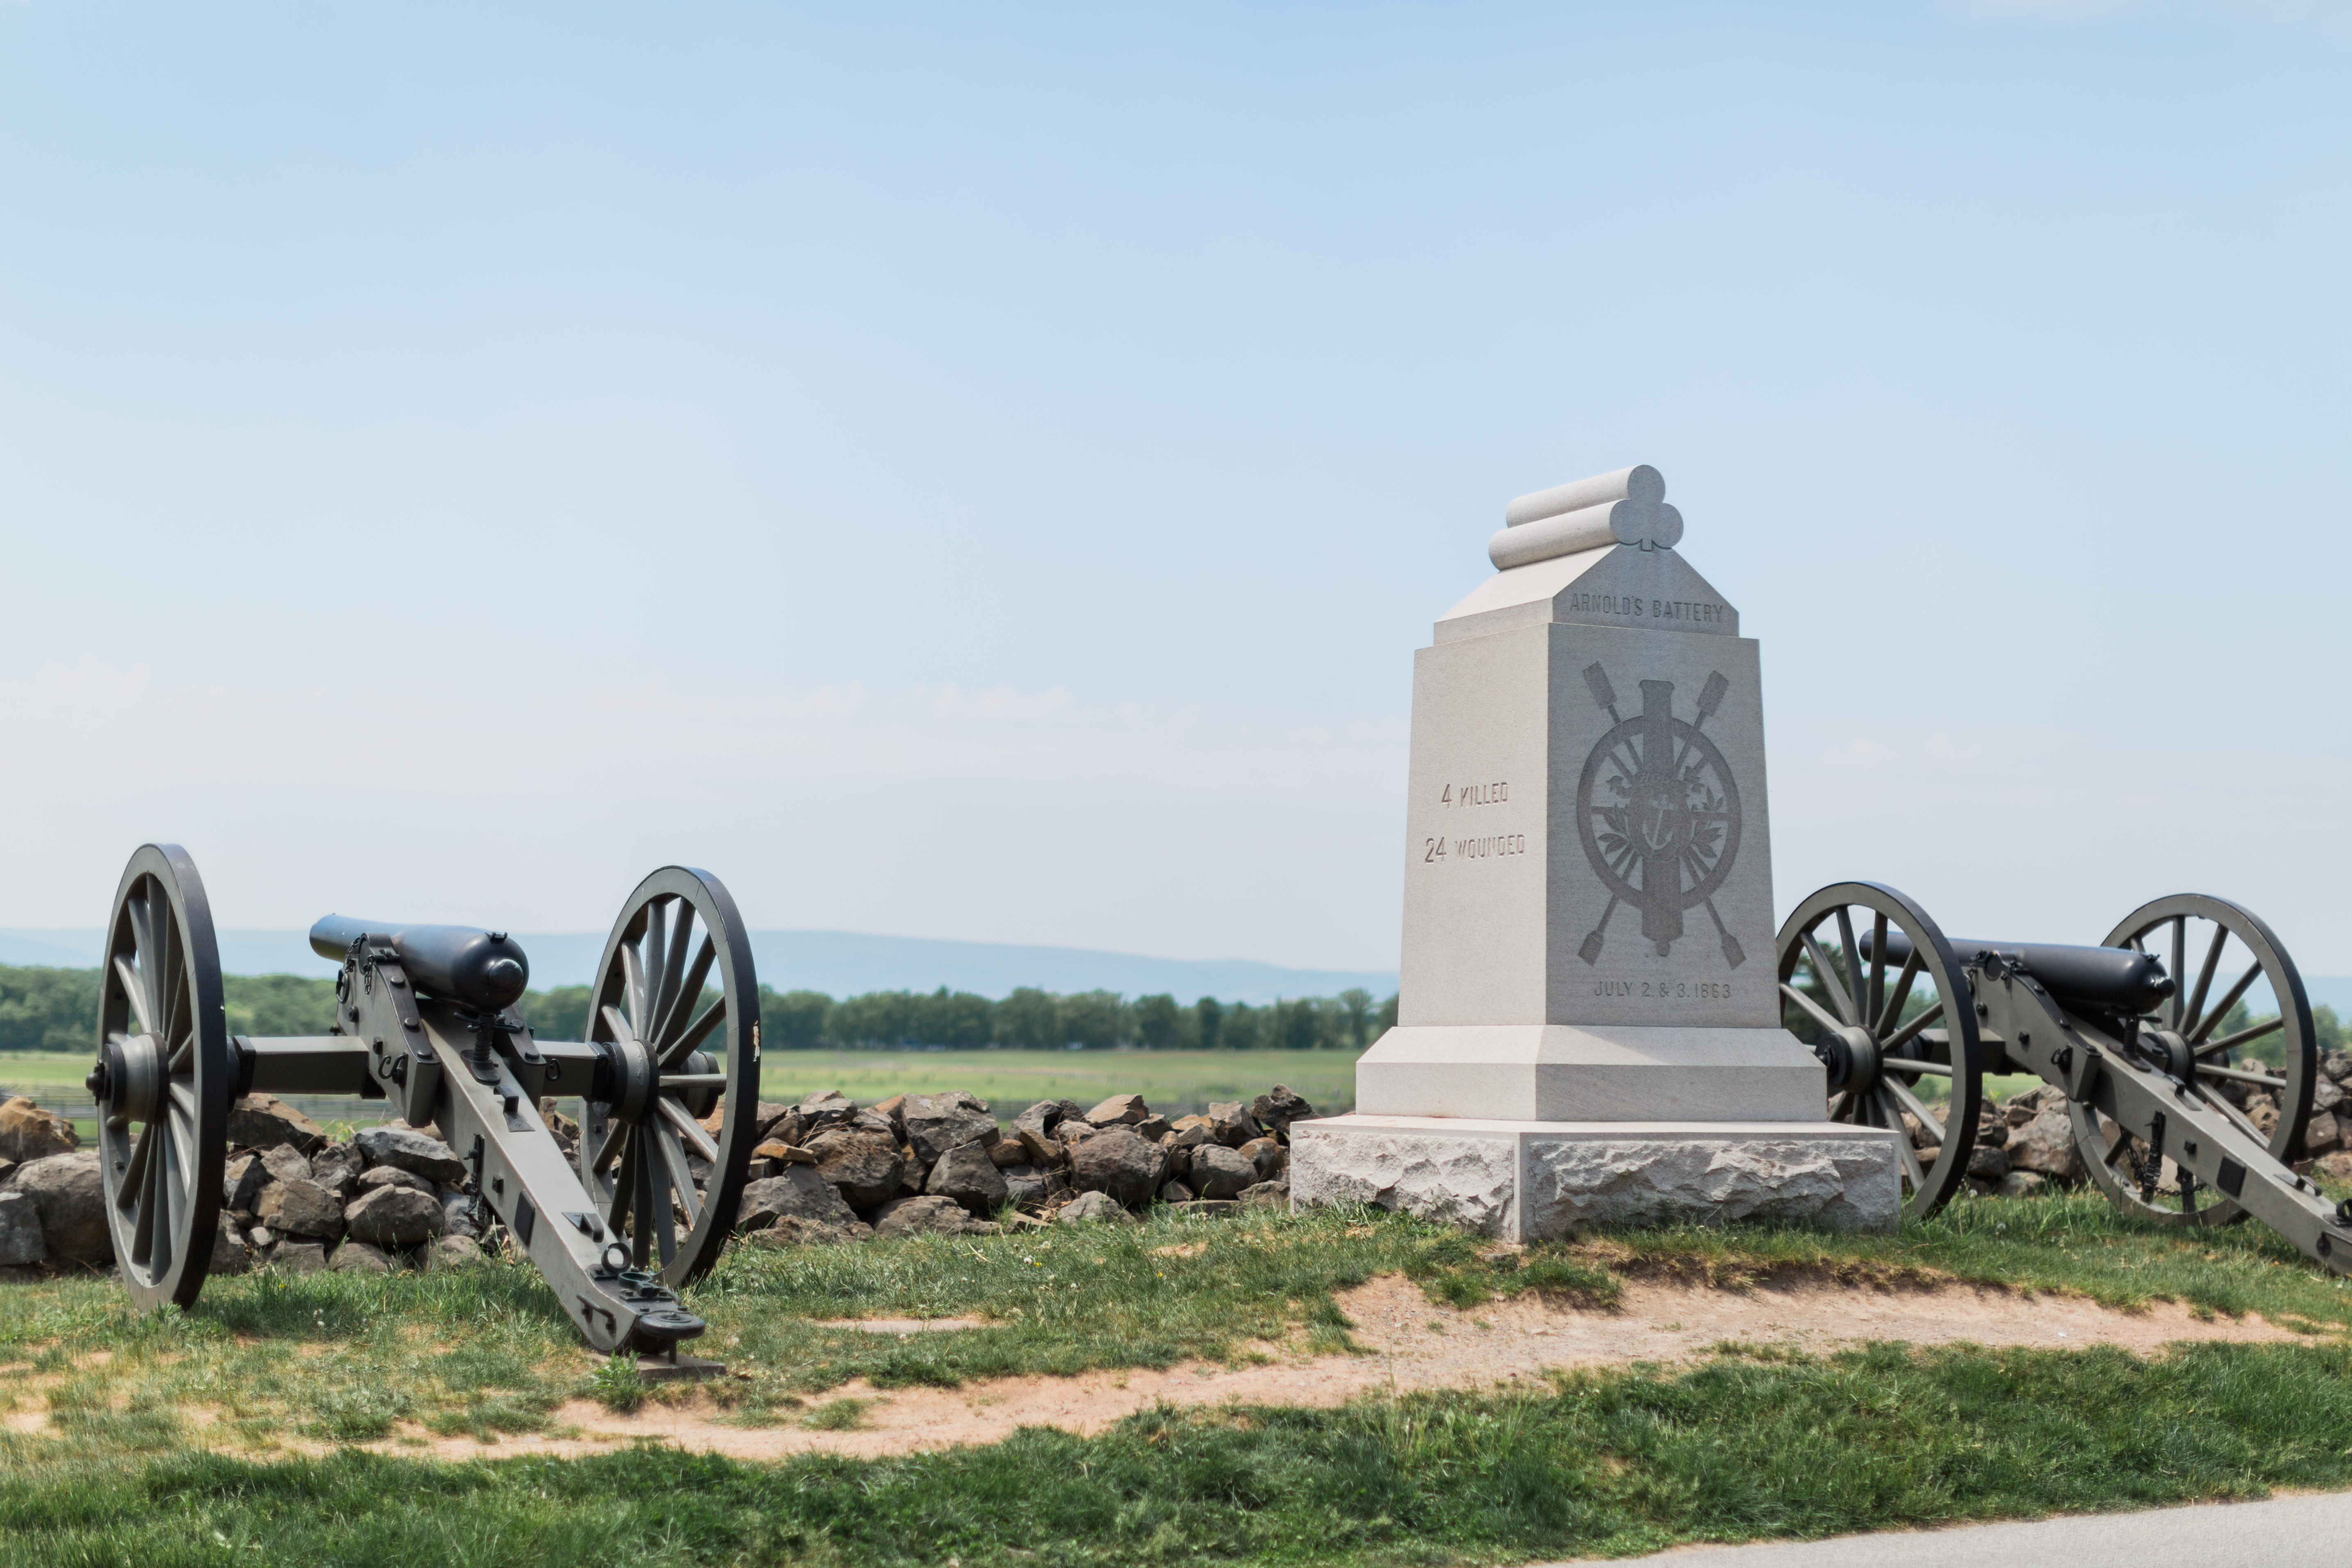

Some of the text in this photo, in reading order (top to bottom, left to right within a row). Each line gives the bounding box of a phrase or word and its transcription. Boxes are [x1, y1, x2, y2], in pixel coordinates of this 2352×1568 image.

[1570, 593, 1724, 623] ARNOLD'S BATTERY
[1441, 782, 1508, 810] 4 KILLED
[1425, 834, 1525, 865] 24 WOUNDED
[1594, 981, 1634, 997] JULY
[1659, 983, 1669, 998] &
